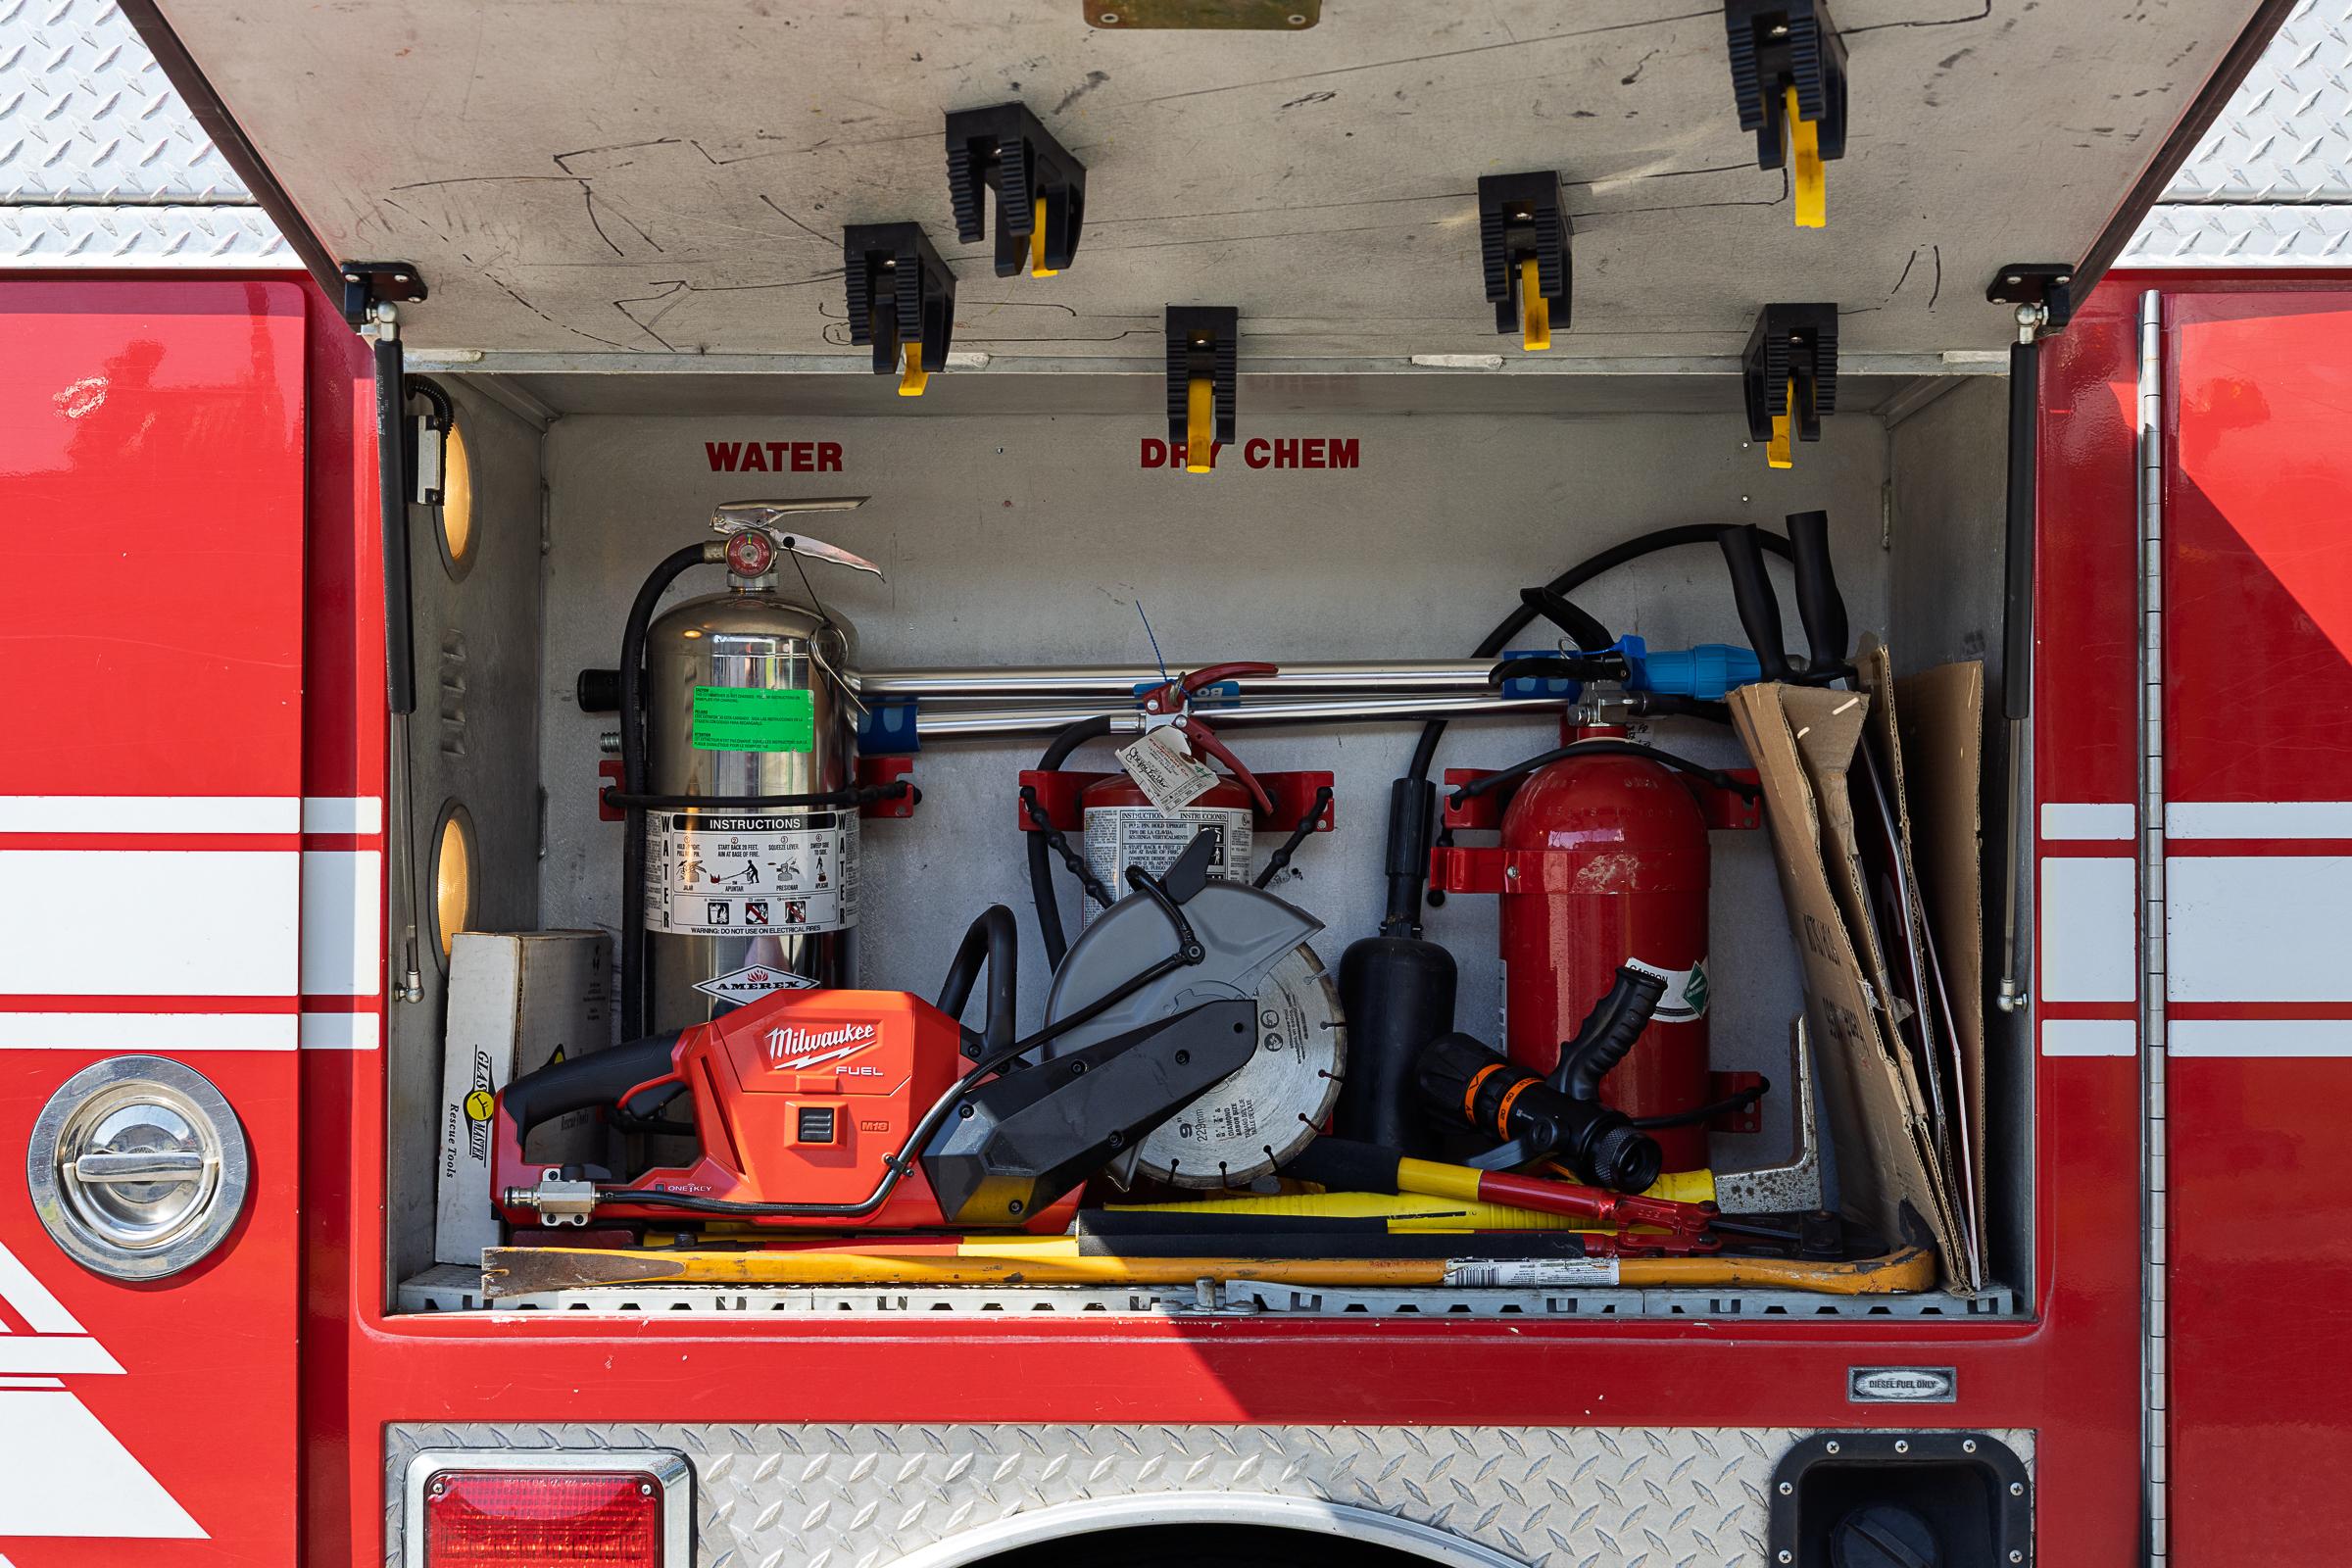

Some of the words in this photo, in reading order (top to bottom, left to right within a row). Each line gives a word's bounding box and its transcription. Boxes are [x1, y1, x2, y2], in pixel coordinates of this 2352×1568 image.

[707, 442, 842, 471] WATER
[1244, 438, 1359, 469] CHEM
[710, 818, 801, 830] INSTRUCTIONS
[716, 981, 800, 990] AMEREX
[764, 1023, 875, 1060] Milwaukee
[836, 1065, 884, 1076] FUEL
[1505, 1092, 1514, 1102] 40
[450, 1103, 459, 1145] Rescue
[861, 1121, 889, 1132] M18
[1196, 1109, 1208, 1143] 229mm
[1224, 1107, 1235, 1137] DIAMOND
[1233, 1117, 1242, 1136] ARBOR
[471, 1121, 485, 1160] MASTER
[447, 1148, 458, 1179] Tools
[1869, 1380, 1895, 1389] DIESEL
[1895, 1380, 1915, 1389] FUEL
[1917, 1380, 1936, 1389] ONLY
